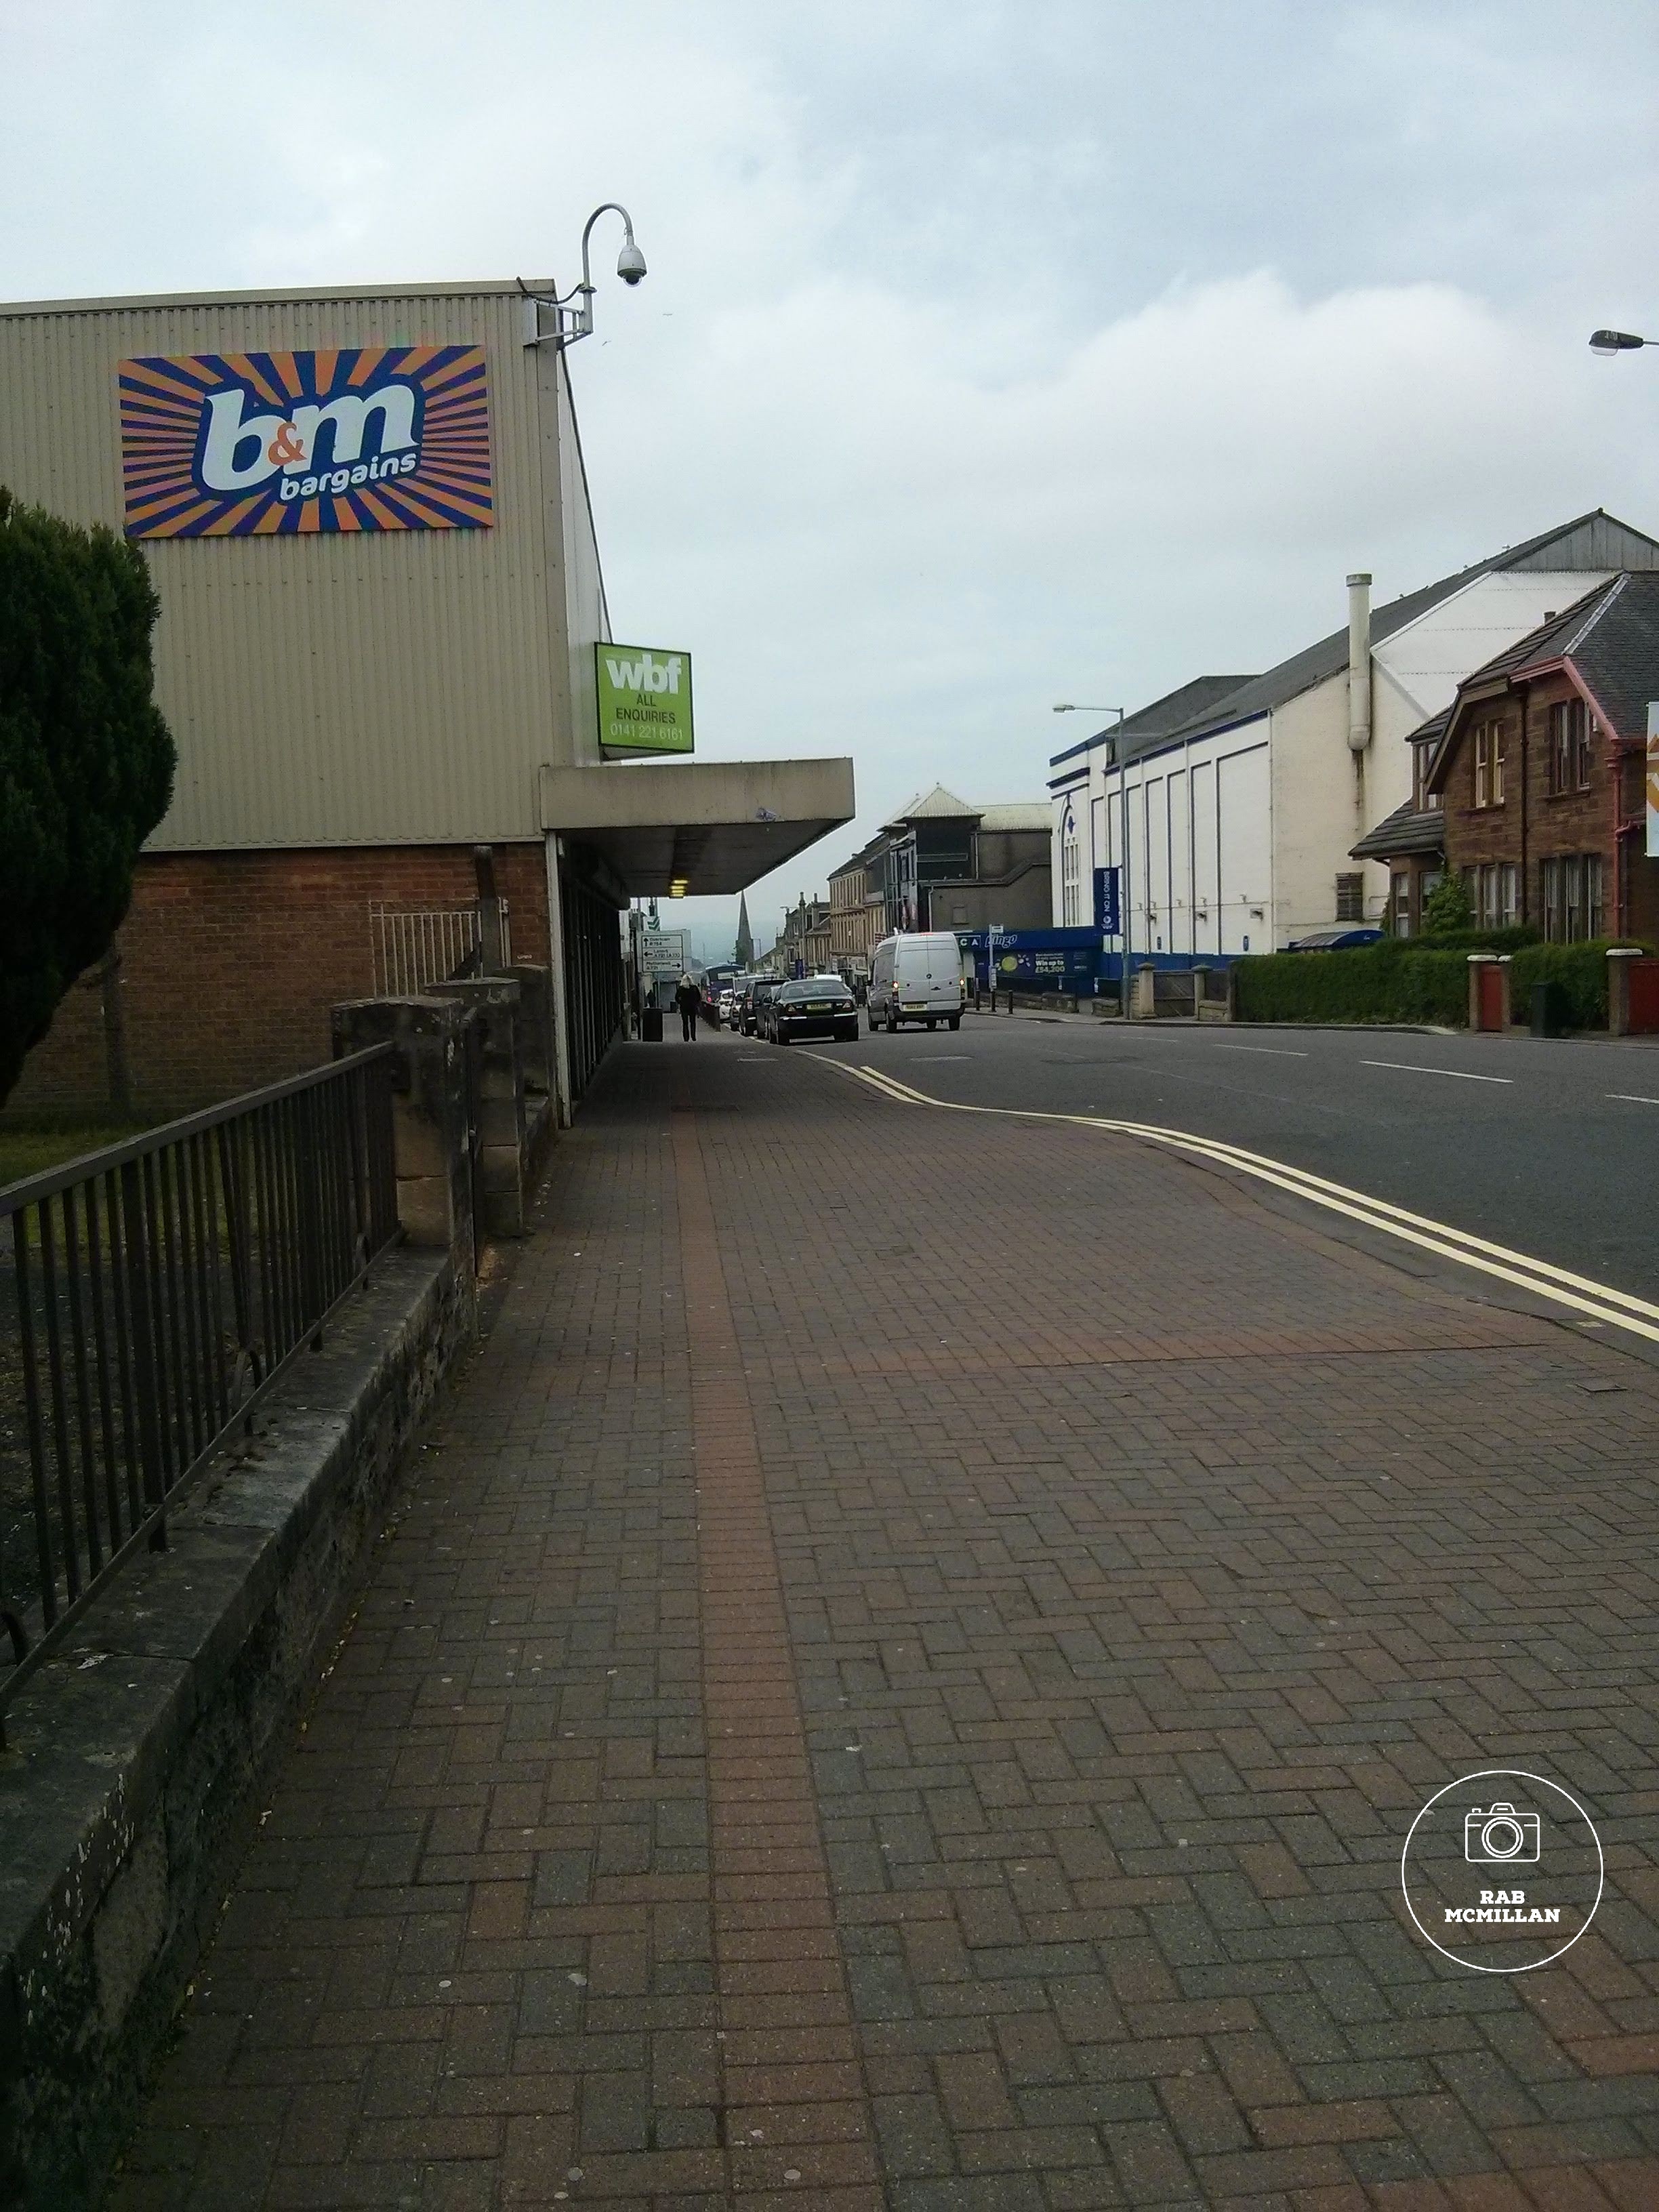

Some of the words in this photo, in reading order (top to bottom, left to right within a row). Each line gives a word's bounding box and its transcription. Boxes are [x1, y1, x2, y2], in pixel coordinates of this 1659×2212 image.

[202, 384, 421, 491] b&m
[280, 451, 417, 501] bargains
[605, 653, 682, 695] wbf
[636, 693, 657, 707] ALL
[615, 708, 676, 724] ENQUIRIES
[610, 722, 635, 737] 0141
[638, 725, 657, 739] 221
[659, 727, 683, 741] 6161
[1103, 901, 1111, 912] ON
